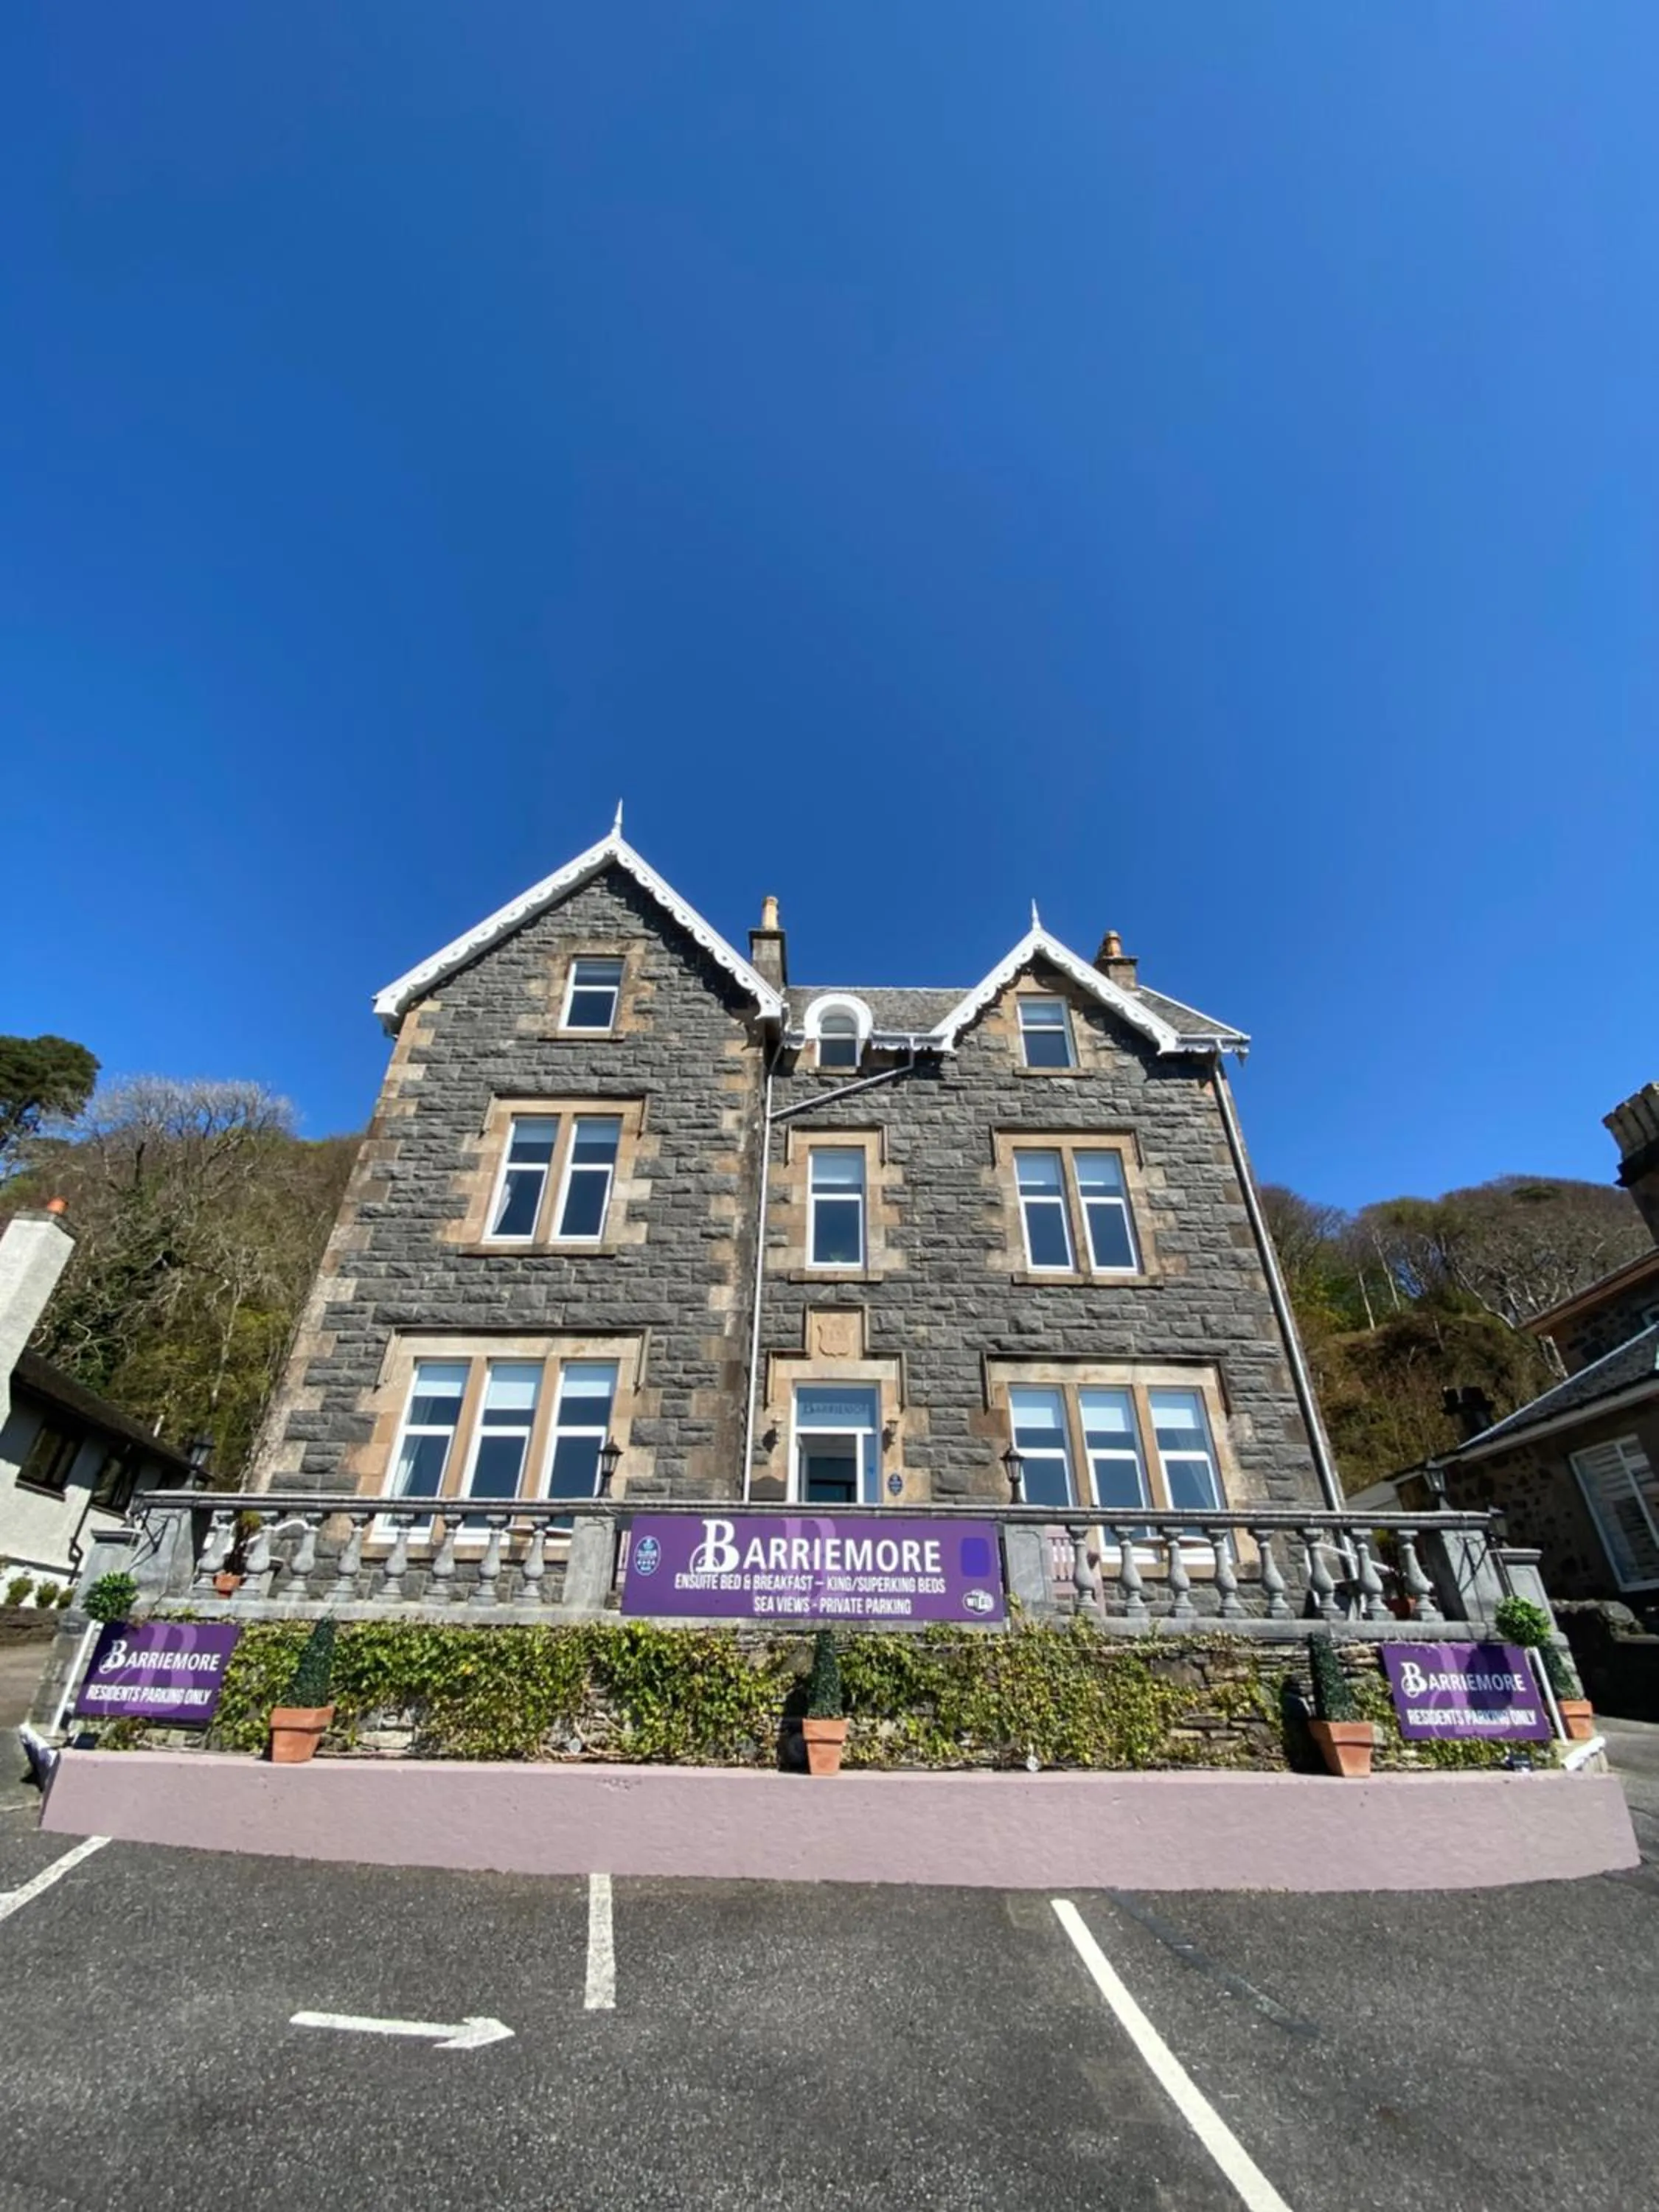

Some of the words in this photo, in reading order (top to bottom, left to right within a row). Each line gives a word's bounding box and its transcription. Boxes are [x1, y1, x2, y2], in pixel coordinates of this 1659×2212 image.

[689, 1519, 942, 1573] BARRIEMORE
[675, 1573, 718, 1590] ENSUITE
[720, 1573, 741, 1590] BED
[753, 1574, 814, 1590] BREAKFAST
[827, 1576, 916, 1593] KING/SUPERKING
[917, 1578, 946, 1593] BEDS
[754, 1596, 774, 1613] SEA
[776, 1596, 810, 1613] VIEWS
[819, 1597, 864, 1614] PRIVATE
[865, 1598, 911, 1615] PARKING
[99, 1639, 220, 1674] BARRIEMORE
[1401, 1662, 1526, 1697] BARRIEMORE
[86, 1684, 141, 1702] RESIDENTS
[141, 1686, 184, 1704] PARKING
[184, 1689, 212, 1705] ONLY
[1407, 1708, 1464, 1725] RESIDENTS
[1511, 1709, 1537, 1725] ONLY
